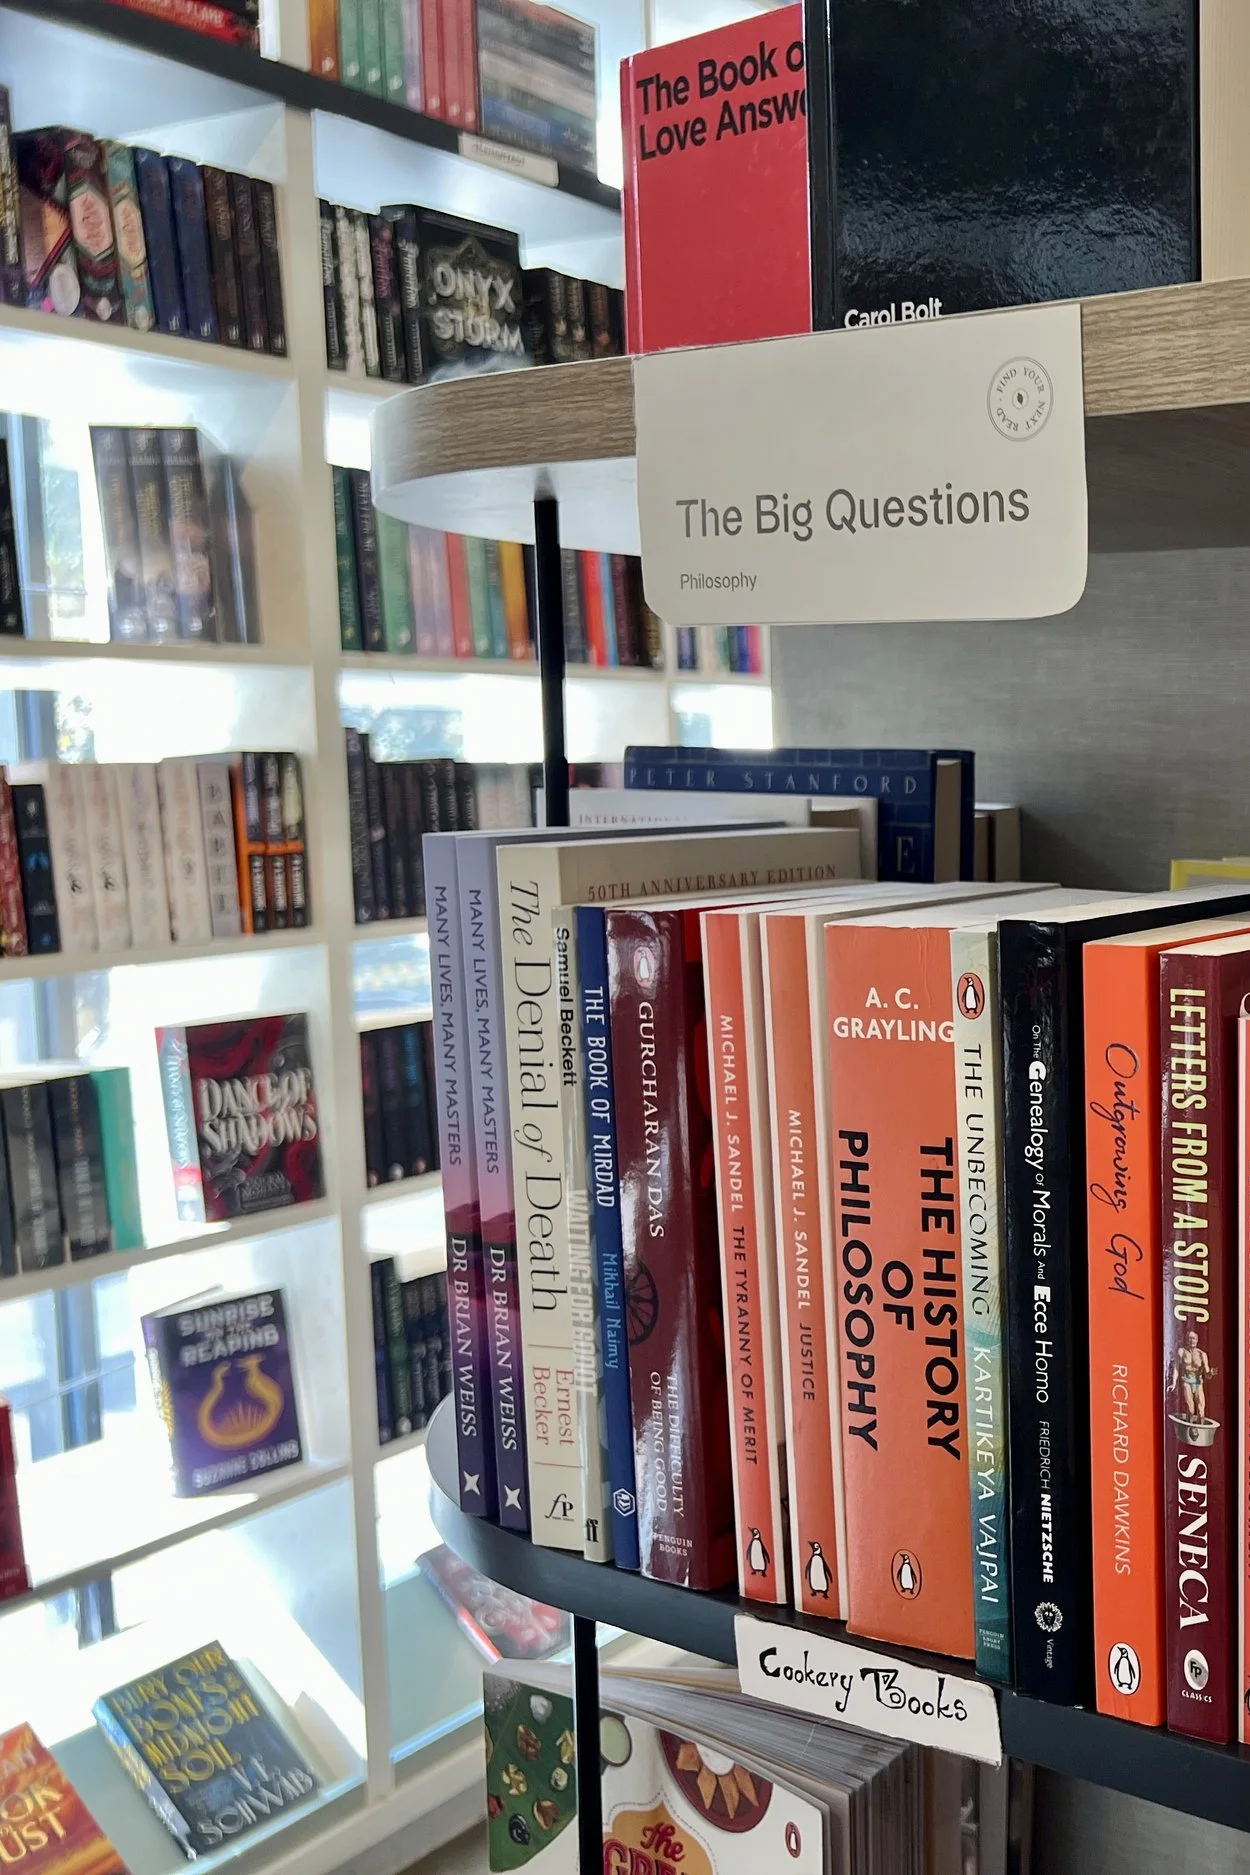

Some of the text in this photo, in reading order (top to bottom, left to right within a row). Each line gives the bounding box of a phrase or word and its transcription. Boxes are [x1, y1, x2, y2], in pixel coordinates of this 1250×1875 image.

[636, 41, 777, 115] The Book
[639, 117, 706, 161] Love
[432, 261, 516, 314] ONYX
[844, 298, 942, 330] Carol Bolt
[432, 308, 525, 356] STORM
[996, 366, 1046, 432] FIND YOUR NEXT READ
[675, 482, 1029, 542] The Big Questions
[680, 572, 757, 592] Philosophy
[629, 766, 919, 795] PETER STANFORD
[587, 864, 837, 901] 50TH ANNIVERSARY EDITION
[434, 886, 462, 1166] MANY LIVES, MANY MASTERS
[555, 927, 577, 1087] Samuel Beckett
[833, 1016, 954, 1043] GRAYLING
[865, 987, 919, 1010] A. C.
[1031, 1025, 1042, 1039] On
[1032, 1041, 1042, 1058] The
[510, 880, 568, 1313] The Denial of Death
[584, 986, 616, 1208] THE BOOK OF MIRDAD
[638, 1002, 664, 1239] GURCHARAN DAS
[1024, 1061, 1049, 1171] Genealogy
[1089, 1042, 1144, 1300] Outgrowing God
[1170, 987, 1209, 1323] LETTERS FROM A STOIC
[719, 1014, 758, 1465] MICHAEL J. SANDEL THE TYRANNY OF MERIT
[788, 1110, 815, 1401] MICHAEL J. SANDEL JUSTICE
[1032, 1189, 1052, 1257] Morals
[838, 1130, 879, 1451] PHILOSOPHY
[881, 1260, 915, 1331] OF
[920, 1137, 961, 1460] THE HISTORY
[1037, 1261, 1046, 1279] And
[178, 1294, 275, 1337] SUNRISE
[452, 1238, 478, 1438] DR BRIAN WEISS
[601, 1252, 622, 1369] Mikhail Naimy
[963, 1044, 1000, 1603] THE UNBECOMING KARTIKEYA VAJPAI
[1034, 1285, 1051, 1334] Ecce
[532, 1366, 551, 1446] Becker
[1035, 1340, 1053, 1403] Homo
[555, 1369, 575, 1446] Ernest
[650, 1371, 667, 1512] OF BEING GOOD
[251, 1438, 299, 1472] COLLINS
[666, 1373, 685, 1518] THE DIFFICULTY
[1111, 1363, 1131, 1576] RICHARD DAWKINS
[1039, 1421, 1053, 1583] FRIEDRICH NIETZSCHE
[653, 1532, 693, 1548] PENGUIN
[659, 1543, 688, 1557] BOOKS
[1177, 1453, 1210, 1630] SENECA
[758, 1645, 853, 1713] Cookery
[1044, 1638, 1054, 1669] Vintage
[1181, 1689, 1213, 1703] CLASSICS
